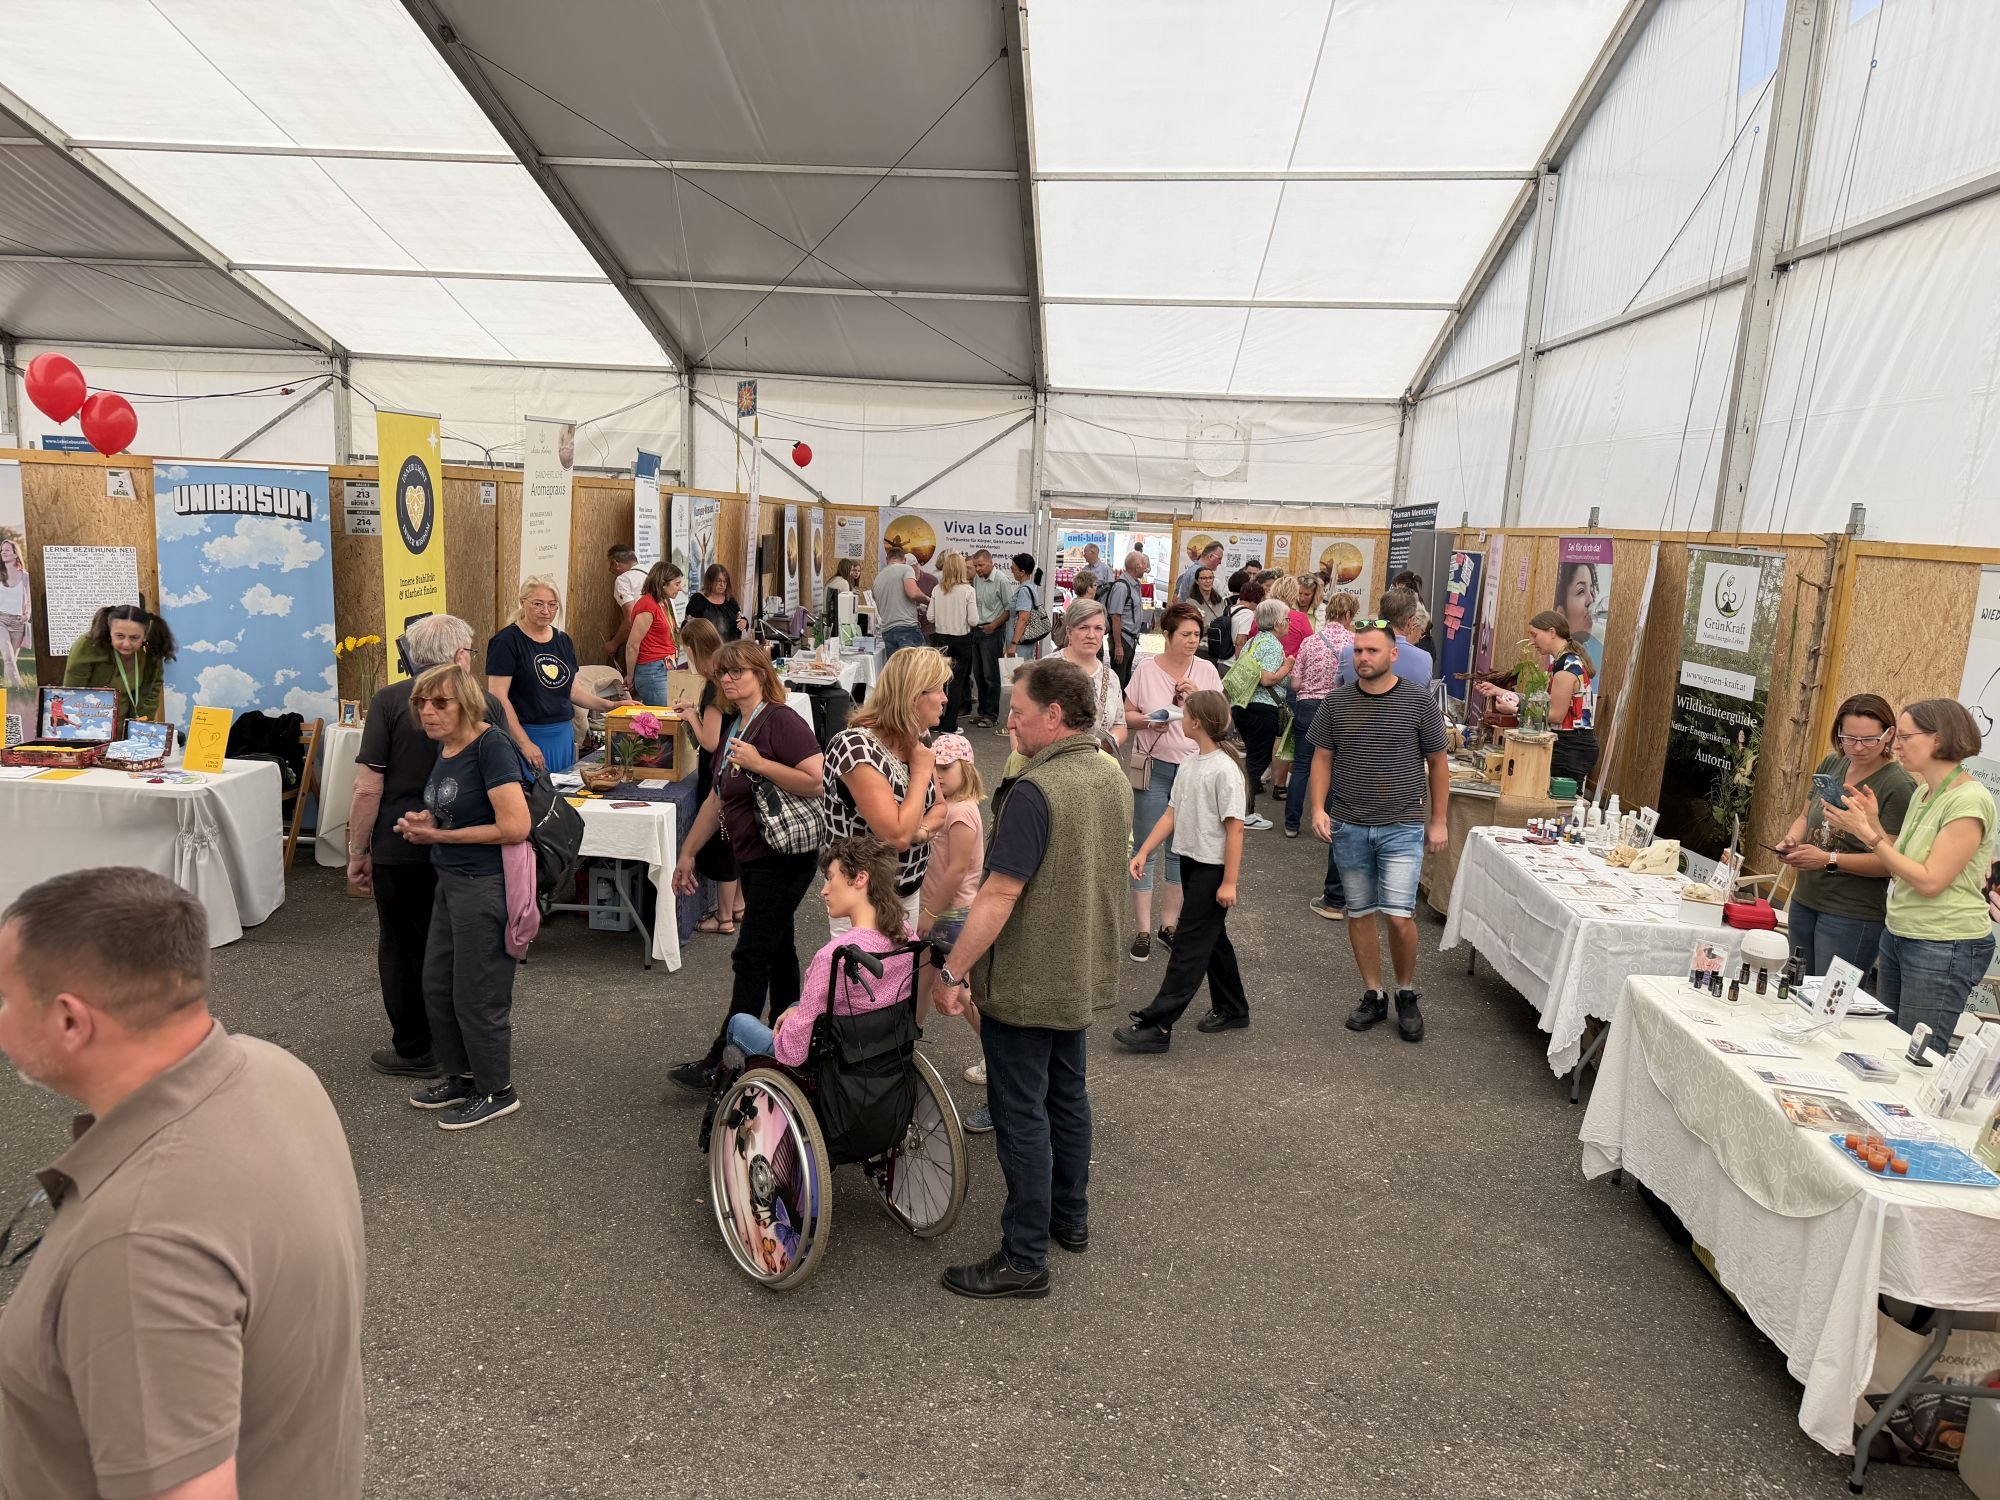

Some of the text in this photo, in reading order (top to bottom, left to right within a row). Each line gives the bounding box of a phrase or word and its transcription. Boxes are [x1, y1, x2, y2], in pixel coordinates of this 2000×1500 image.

[356, 491, 370, 499] 213
[531, 482, 566, 499] Aromapraxis
[173, 484, 312, 521] UNIBRISUM
[356, 518, 372, 526] 214
[1393, 508, 1437, 519] Human Mentoring
[944, 521, 1028, 537] Viva la Soul
[399, 578, 415, 587] Innere
[405, 587, 423, 600] Klarheit
[423, 585, 438, 596] finden
[1704, 617, 1746, 635] GrünKraft
[1686, 671, 1746, 692] www.gruen-kraft.at
[1676, 694, 1758, 729] Wildkräuterguide
[1670, 719, 1731, 746] Natur-Energetikerin
[1694, 747, 1732, 771] Autorin
